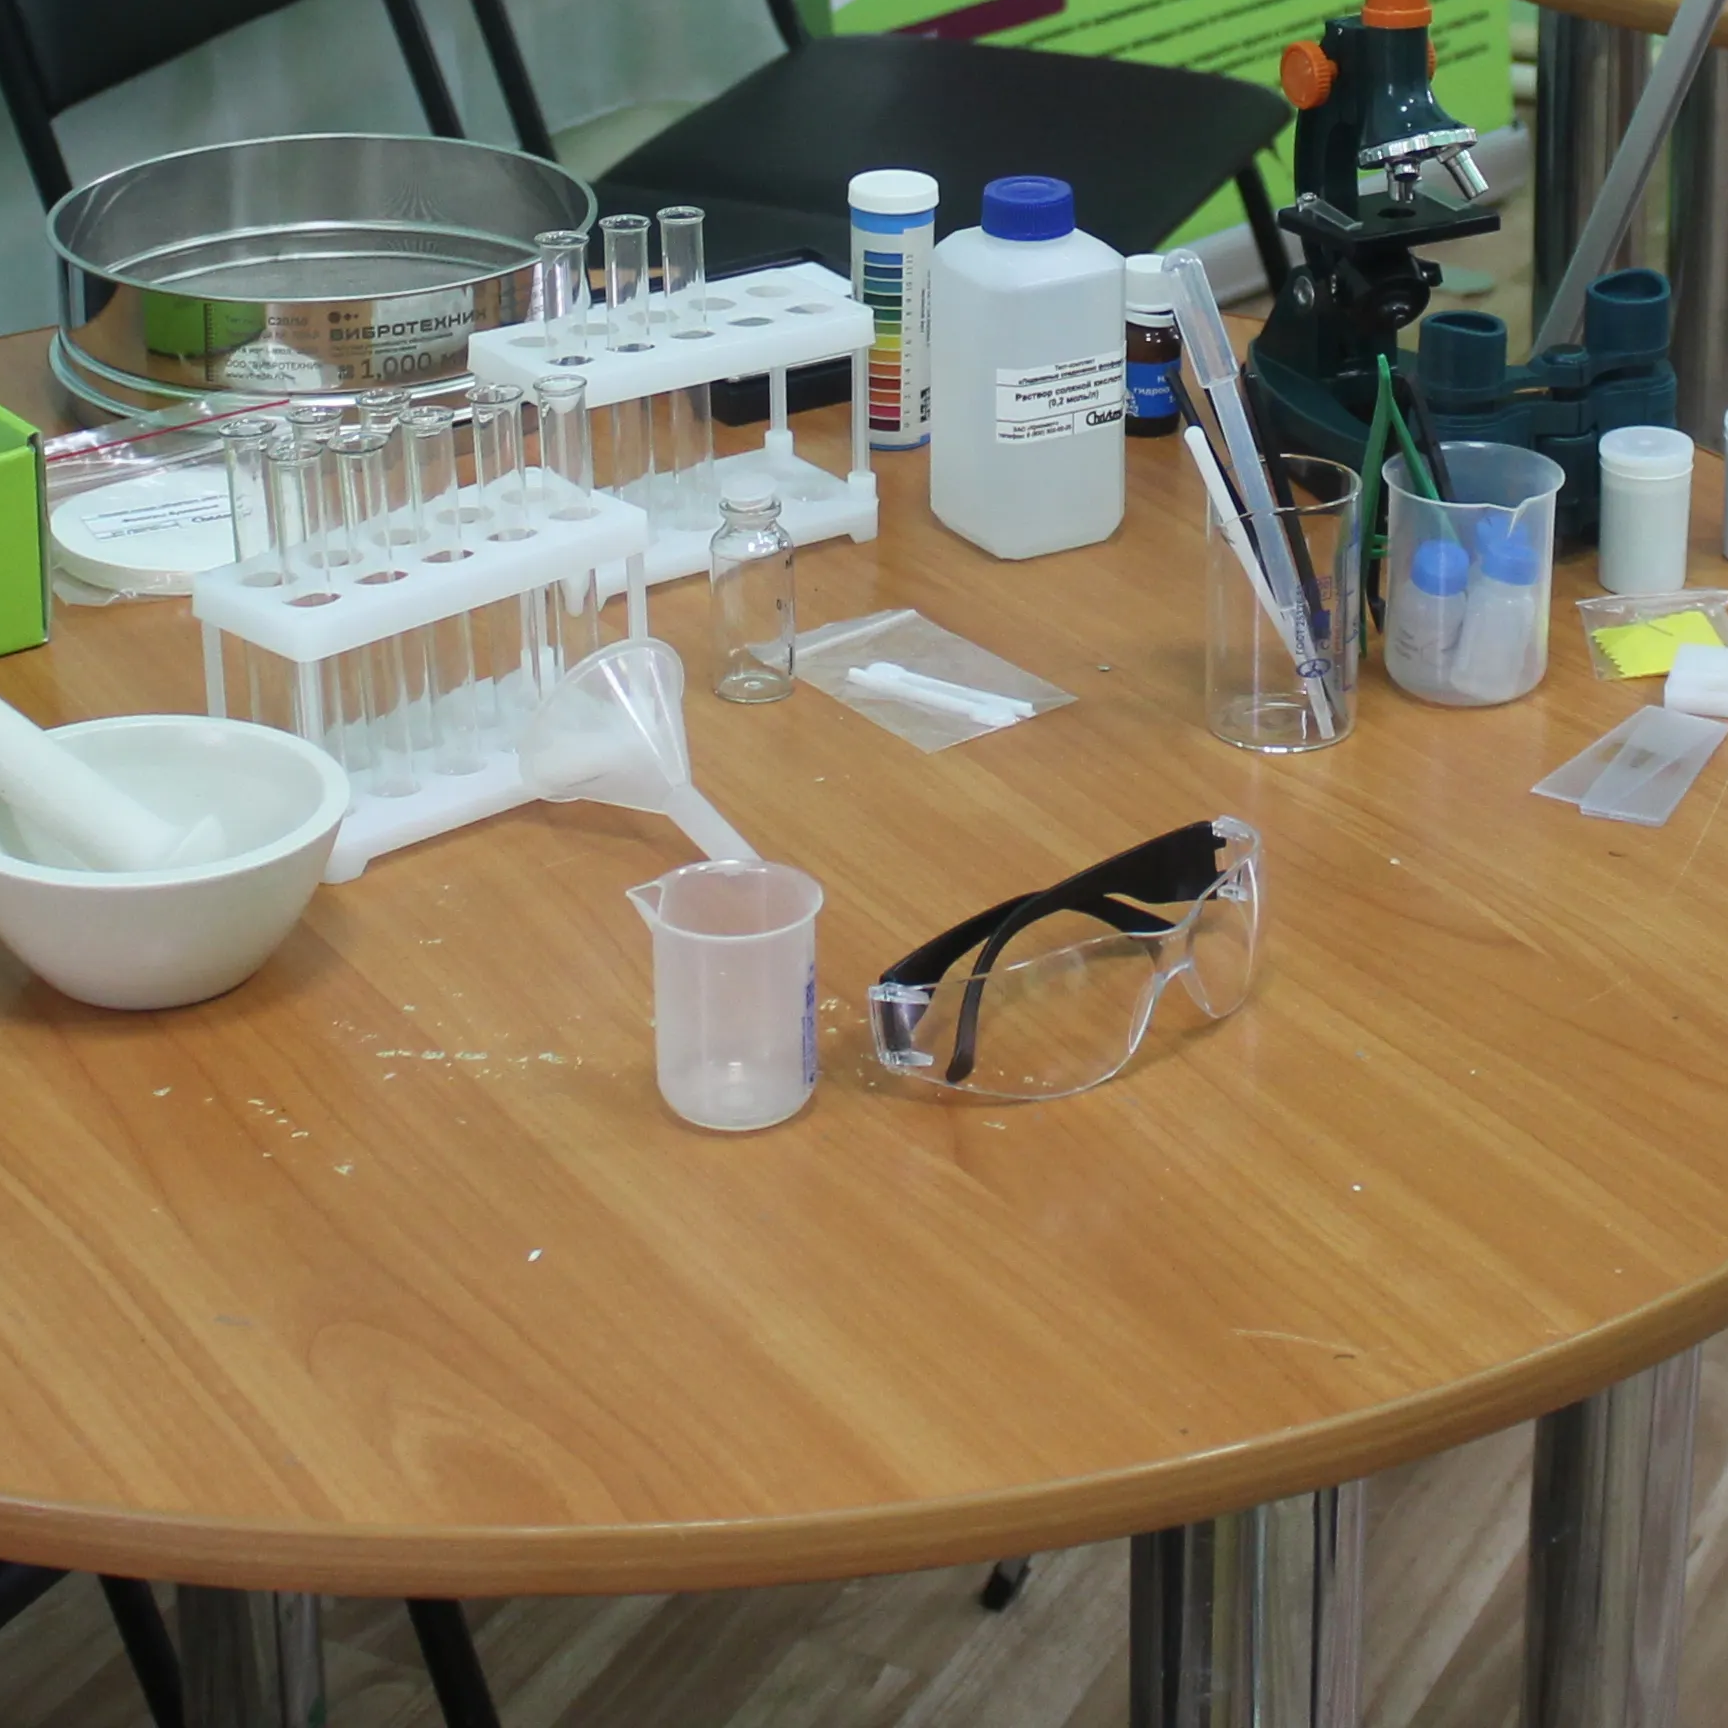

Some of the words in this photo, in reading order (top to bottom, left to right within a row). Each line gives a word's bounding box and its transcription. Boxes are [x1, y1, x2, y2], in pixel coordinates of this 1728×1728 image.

[329, 308, 487, 341] ВИБРОТЕХНИК
[361, 351, 432, 381] 1,000
[1015, 390, 1053, 402] Раствор
[1055, 381, 1092, 396] соляной
[1048, 396, 1064, 409] (0,2
[1066, 390, 1099, 404] моль/л)
[1013, 425, 1026, 433] ЗАО
